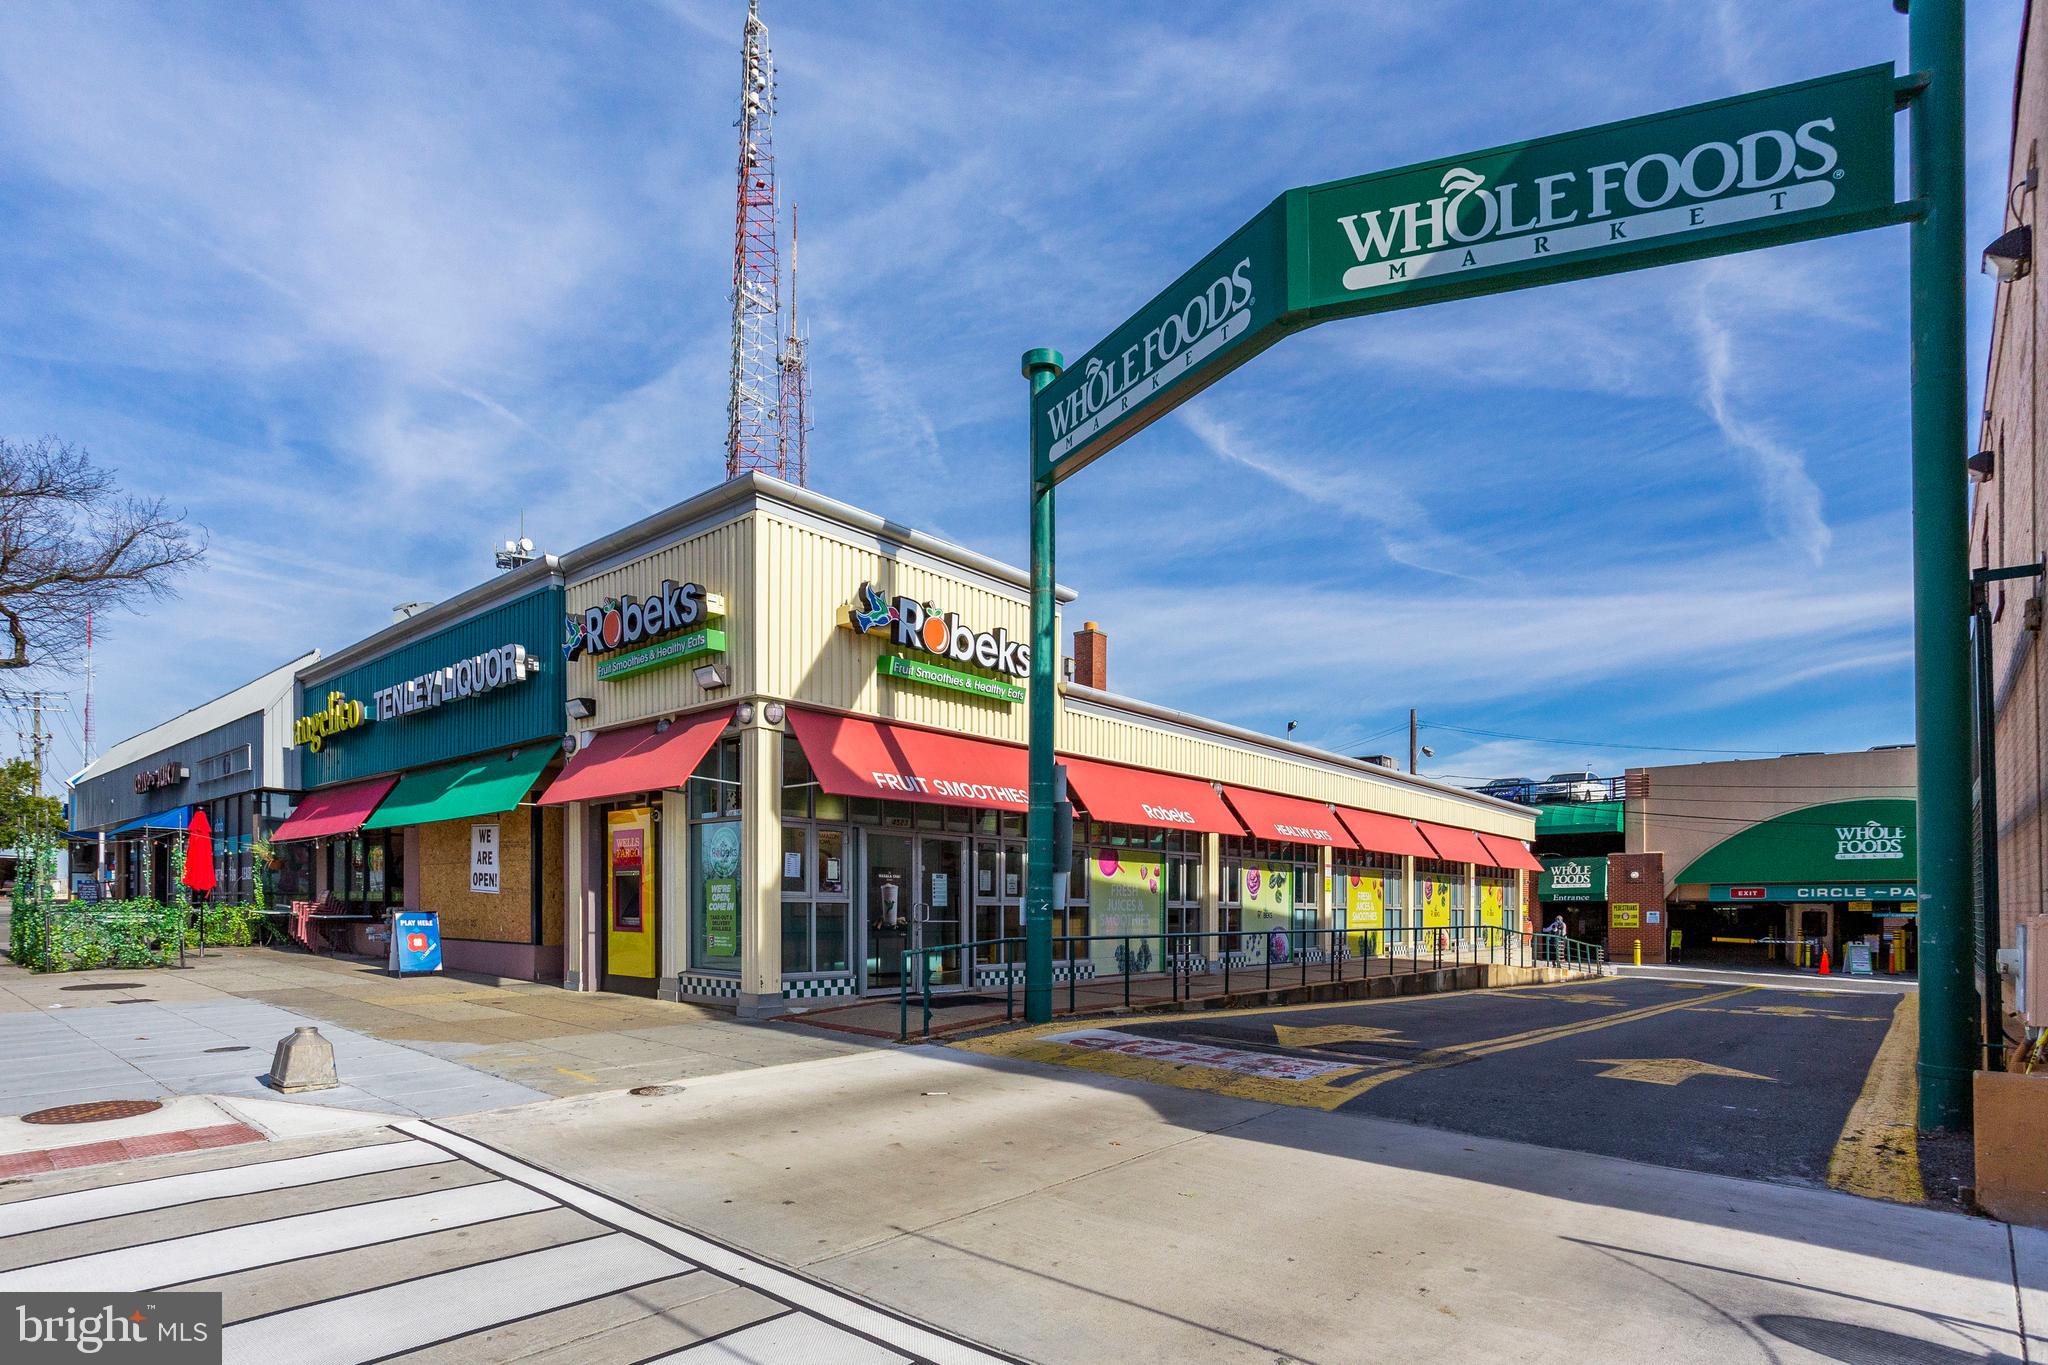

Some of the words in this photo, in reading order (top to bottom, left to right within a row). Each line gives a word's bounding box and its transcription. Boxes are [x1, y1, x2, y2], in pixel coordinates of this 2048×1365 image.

[1337, 168, 1577, 262] WHOLE
[1587, 117, 1839, 219] FOODS
[1388, 192, 1788, 281] MARKET
[1047, 357, 1140, 440] WHOLE
[1142, 256, 1252, 377] FOODS
[1065, 325, 1230, 450] MARKET
[585, 579, 699, 656] Robeks
[896, 596, 1031, 678] Robeks
[597, 664, 612, 676] Fruit
[612, 651, 649, 673] Smoothies
[650, 651, 656, 661] &
[656, 640, 686, 658] Healthy
[687, 634, 705, 649] Eats
[373, 671, 440, 722] TENLEY
[441, 643, 520, 702] LIQUOR
[893, 661, 914, 676] Fruit
[915, 666, 964, 688] Smoothies
[965, 678, 972, 689] &
[974, 680, 1007, 698] Healthy
[1007, 688, 1025, 701] Eats
[293, 690, 361, 753] angelico
[871, 771, 930, 794] FRUIT
[932, 778, 1029, 804] SMOOTHIES
[1141, 803, 1196, 824] Robeks
[478, 828, 492, 843] WE
[1273, 823, 1313, 839] HEALTHY
[1313, 828, 1334, 841] EATS
[1835, 821, 1906, 841] WHOLE
[616, 836, 640, 847] WELLS
[1837, 839, 1902, 854] FOODS
[476, 850, 493, 865] ARE
[615, 846, 640, 858] FARGO
[1550, 862, 1592, 875] WHOLE
[472, 871, 498, 887] OPEN!
[1553, 874, 1591, 884] FOODS
[1111, 883, 1138, 896] FRESH
[1553, 893, 1590, 901] Entrance
[1797, 887, 1867, 898] CIRCLE
[708, 902, 727, 911] COME
[726, 902, 734, 911] IN
[1107, 898, 1137, 912] JUICES
[1099, 913, 1150, 927] SMOOTHIES
